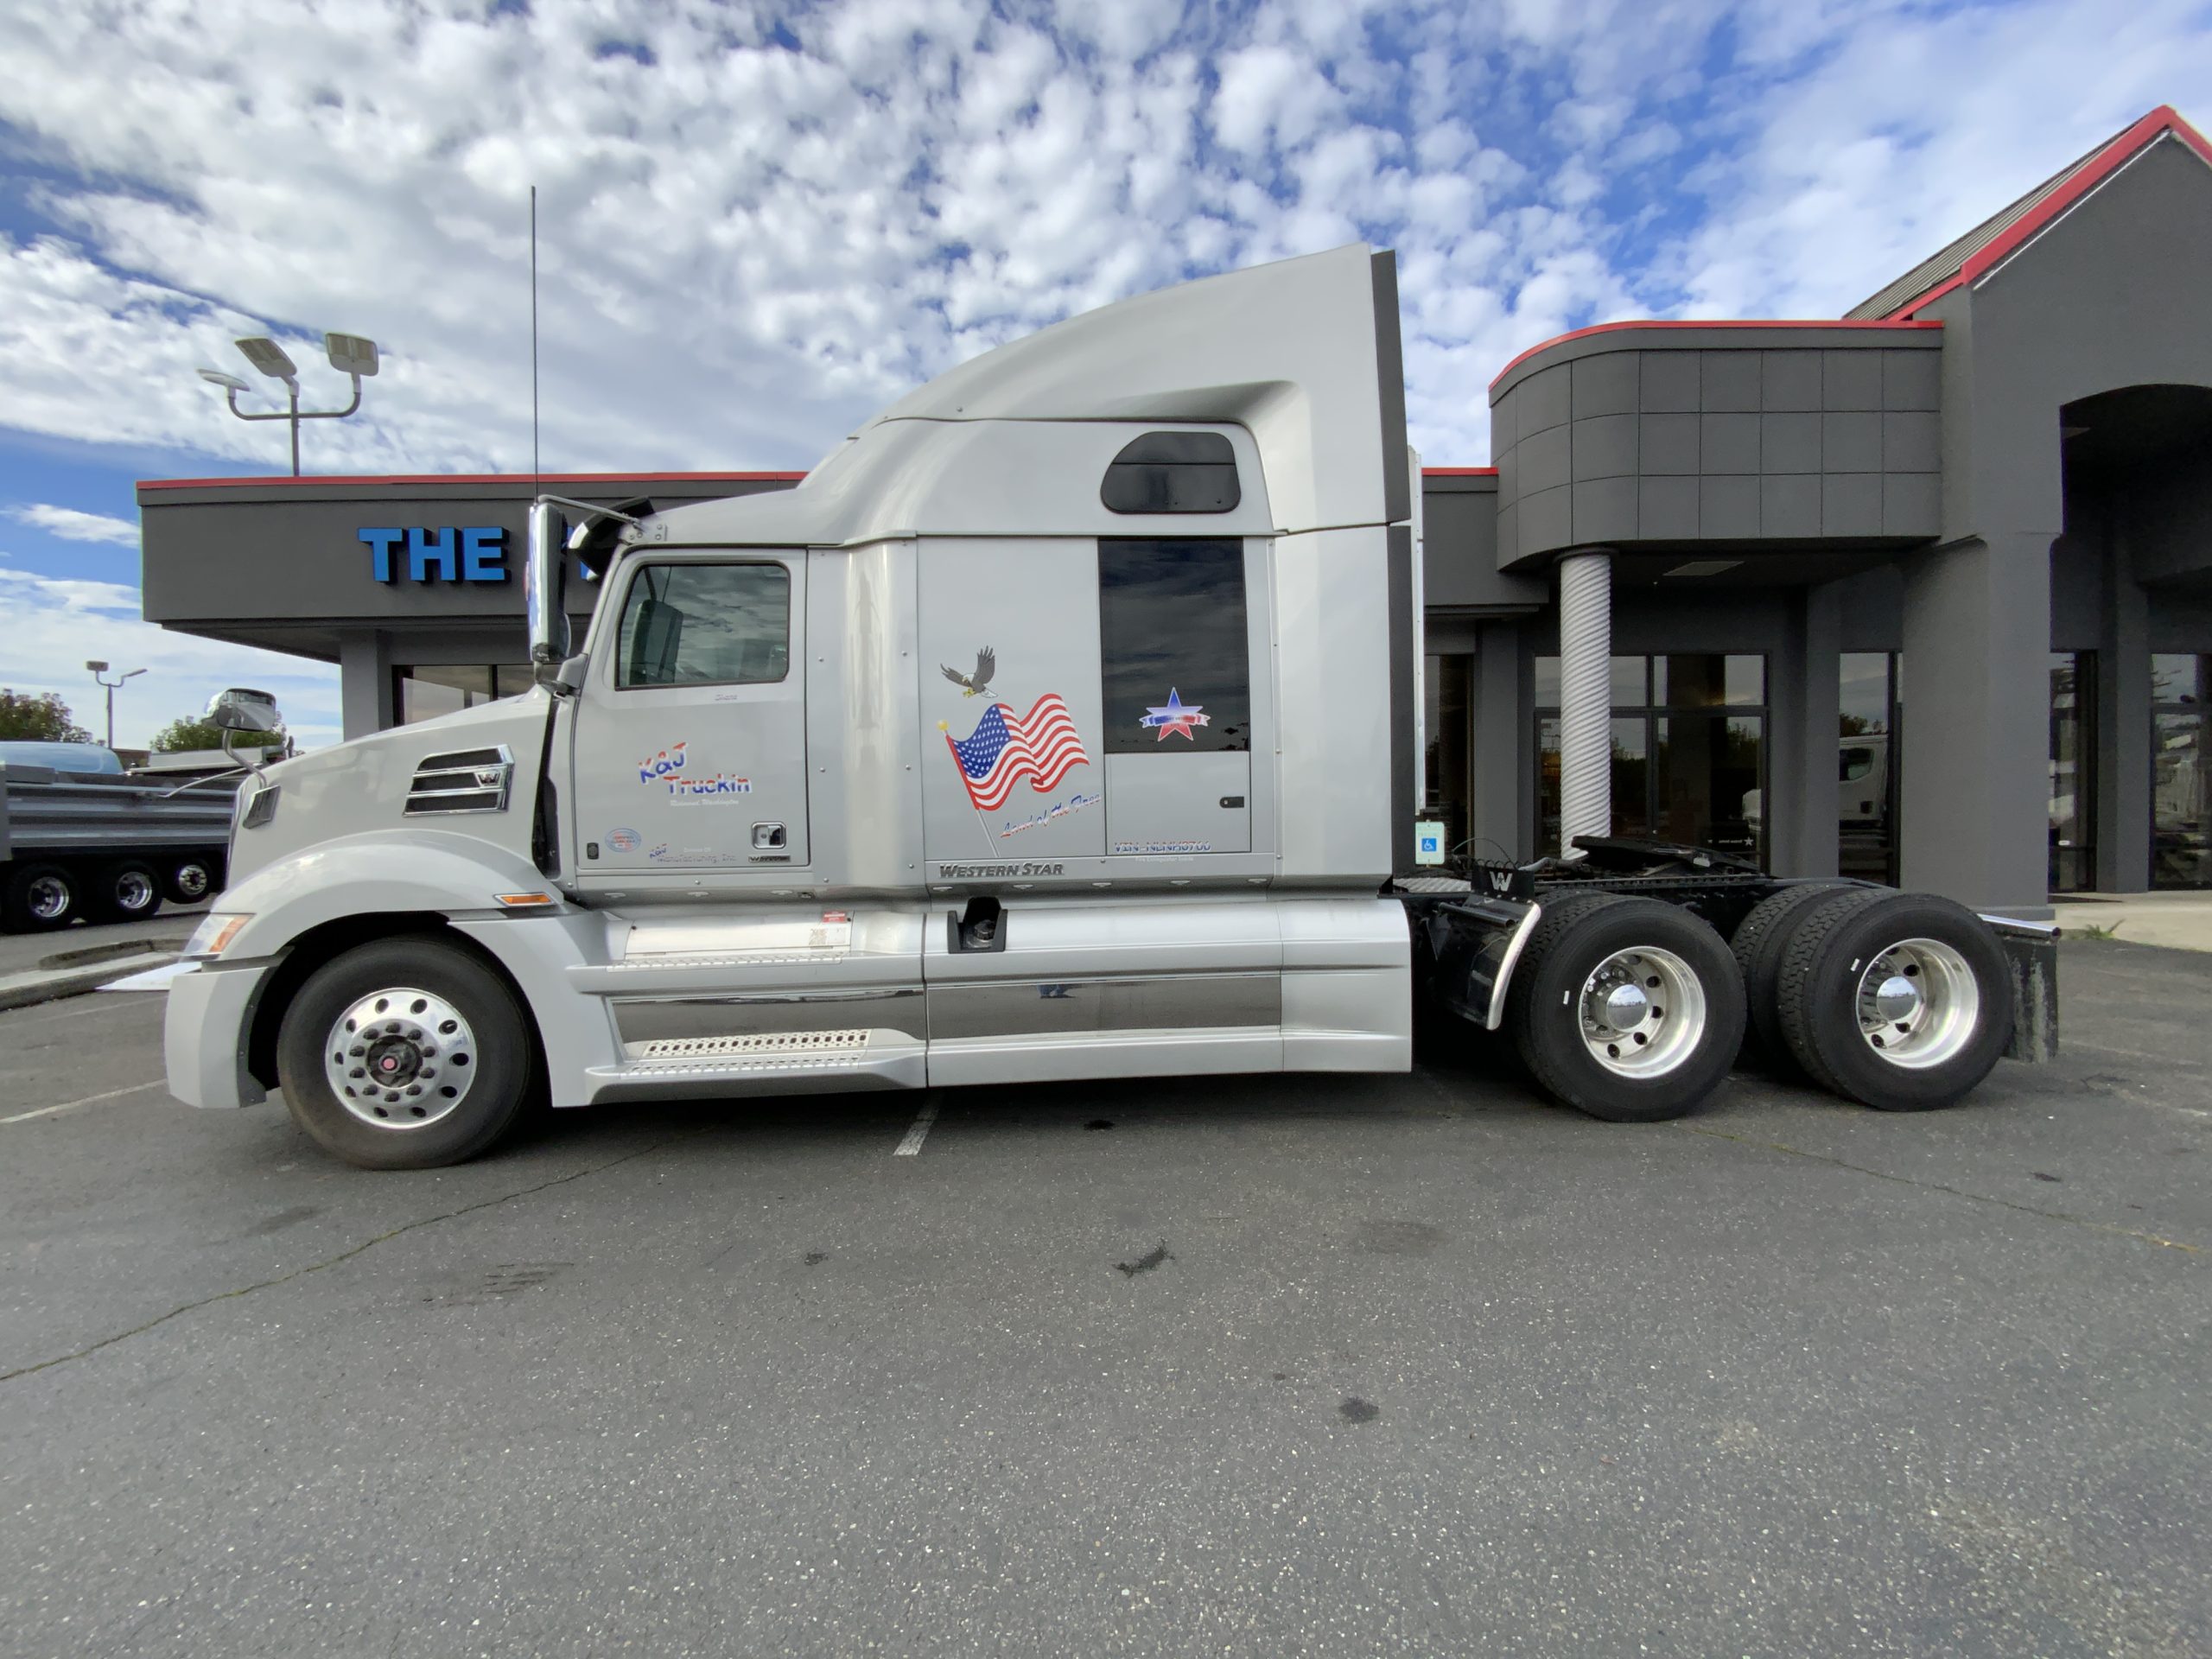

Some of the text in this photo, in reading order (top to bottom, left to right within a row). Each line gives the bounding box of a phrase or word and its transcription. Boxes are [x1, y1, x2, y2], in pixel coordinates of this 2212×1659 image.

[358, 526, 505, 582] THE
[663, 772, 753, 795] Truckin
[1000, 793, 1102, 838] Land of the Free
[939, 862, 1065, 878] WESTERN STAR
